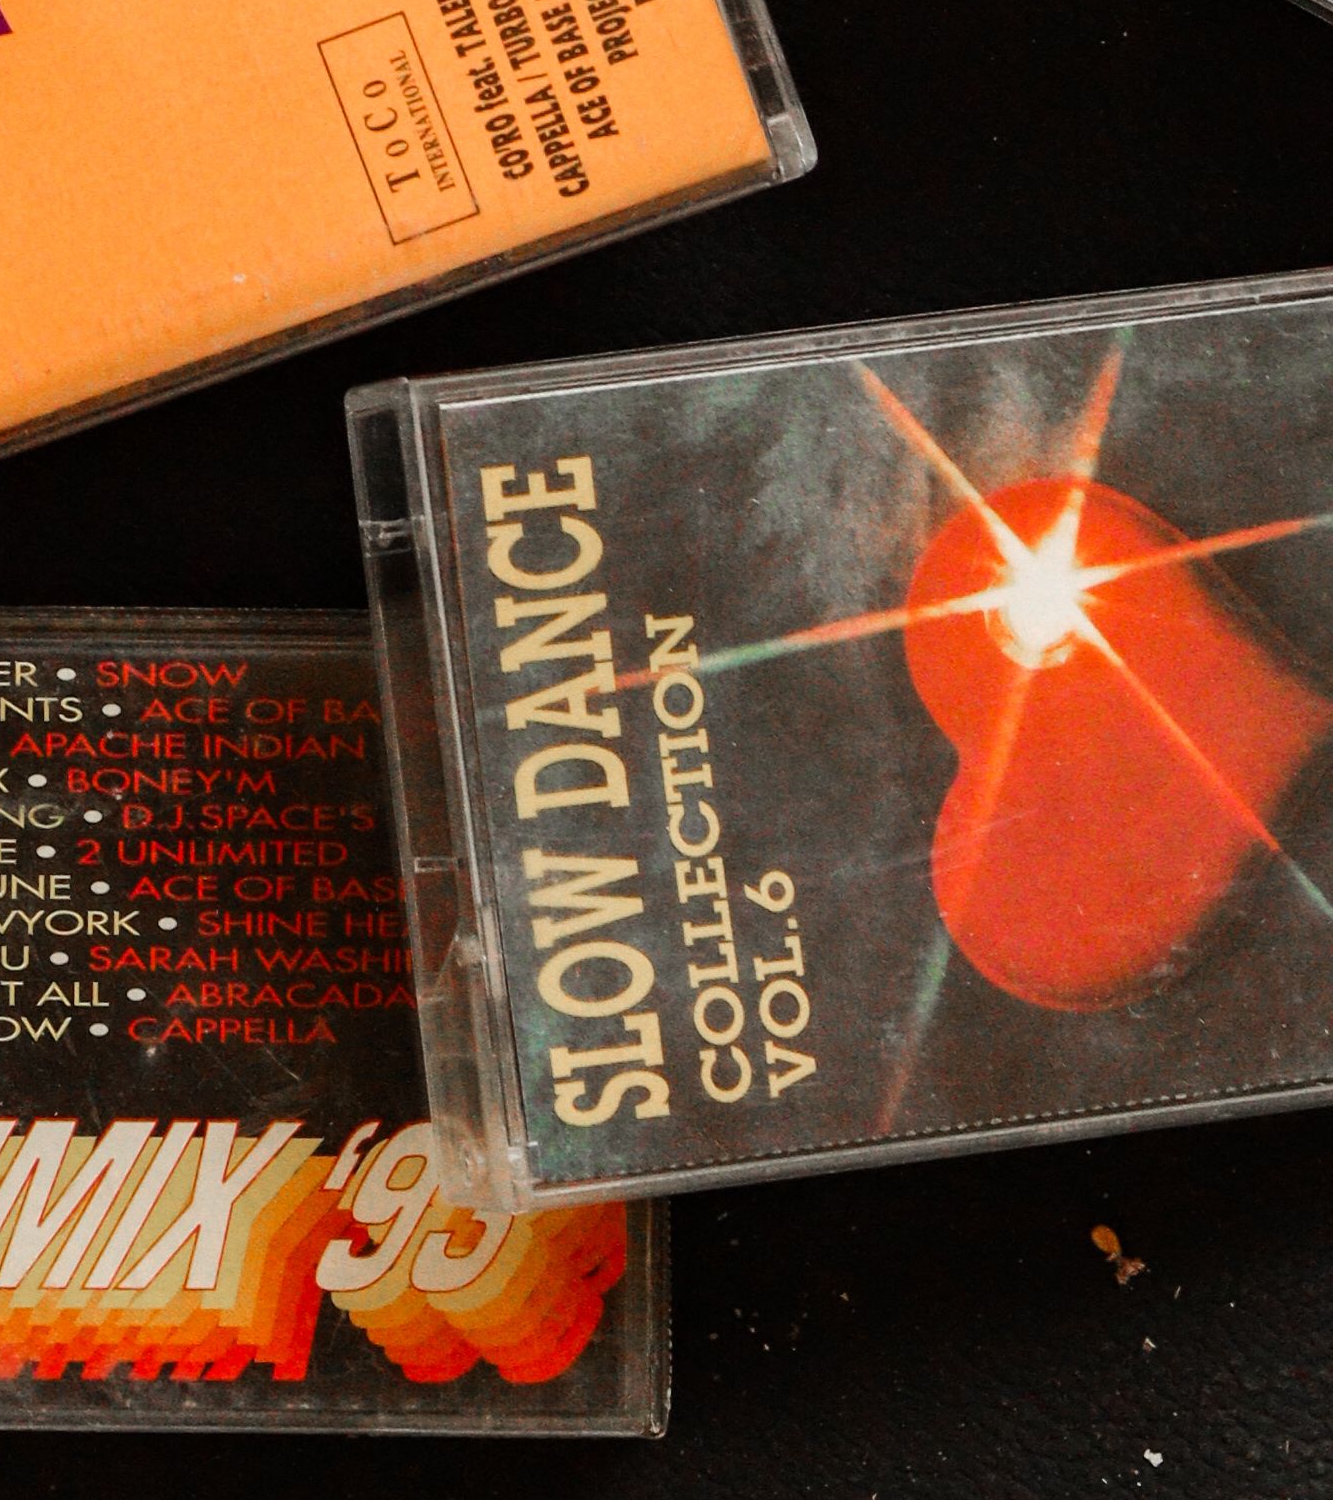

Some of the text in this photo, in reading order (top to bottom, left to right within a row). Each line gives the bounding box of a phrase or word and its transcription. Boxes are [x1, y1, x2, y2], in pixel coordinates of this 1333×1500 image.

[96, 660, 247, 689] SNOW
[480, 456, 670, 1126] SLOW DANCE
[652, 614, 751, 1104] COLLECTION
[744, 870, 817, 1099] VOL.6
